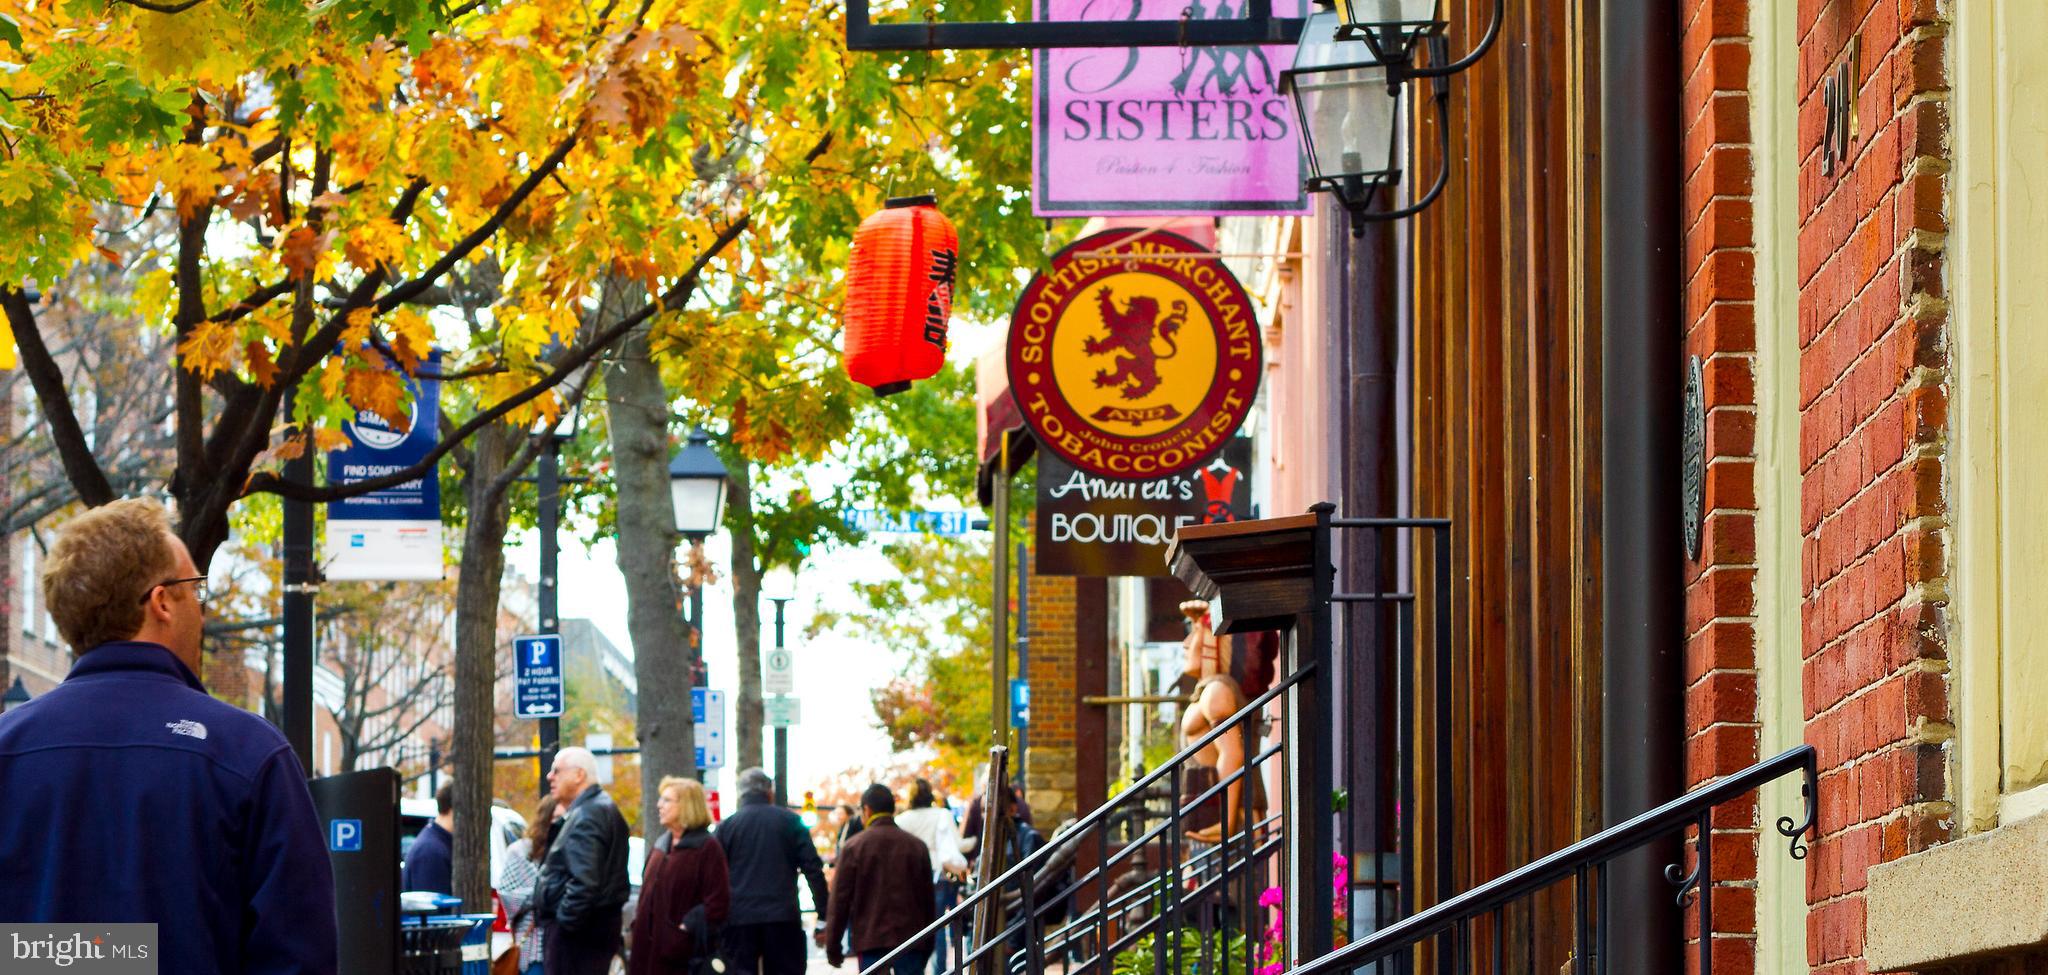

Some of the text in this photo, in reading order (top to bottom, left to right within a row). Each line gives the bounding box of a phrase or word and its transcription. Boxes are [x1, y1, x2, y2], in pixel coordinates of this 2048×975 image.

[1064, 99, 1289, 142] SISTERS
[1096, 154, 1158, 176] Passion
[1187, 155, 1252, 176] Fashion
[1021, 241, 1252, 364] SCOTTISH MERCHANT
[1107, 409, 1166, 420] AND
[1028, 388, 1244, 473] TOBACCONIST
[1079, 427, 1193, 454] John Crouch
[344, 465, 366, 476] FIND
[940, 512, 965, 533] ST
[531, 641, 546, 664] P
[524, 668, 530, 677] 2
[337, 823, 355, 847] P
